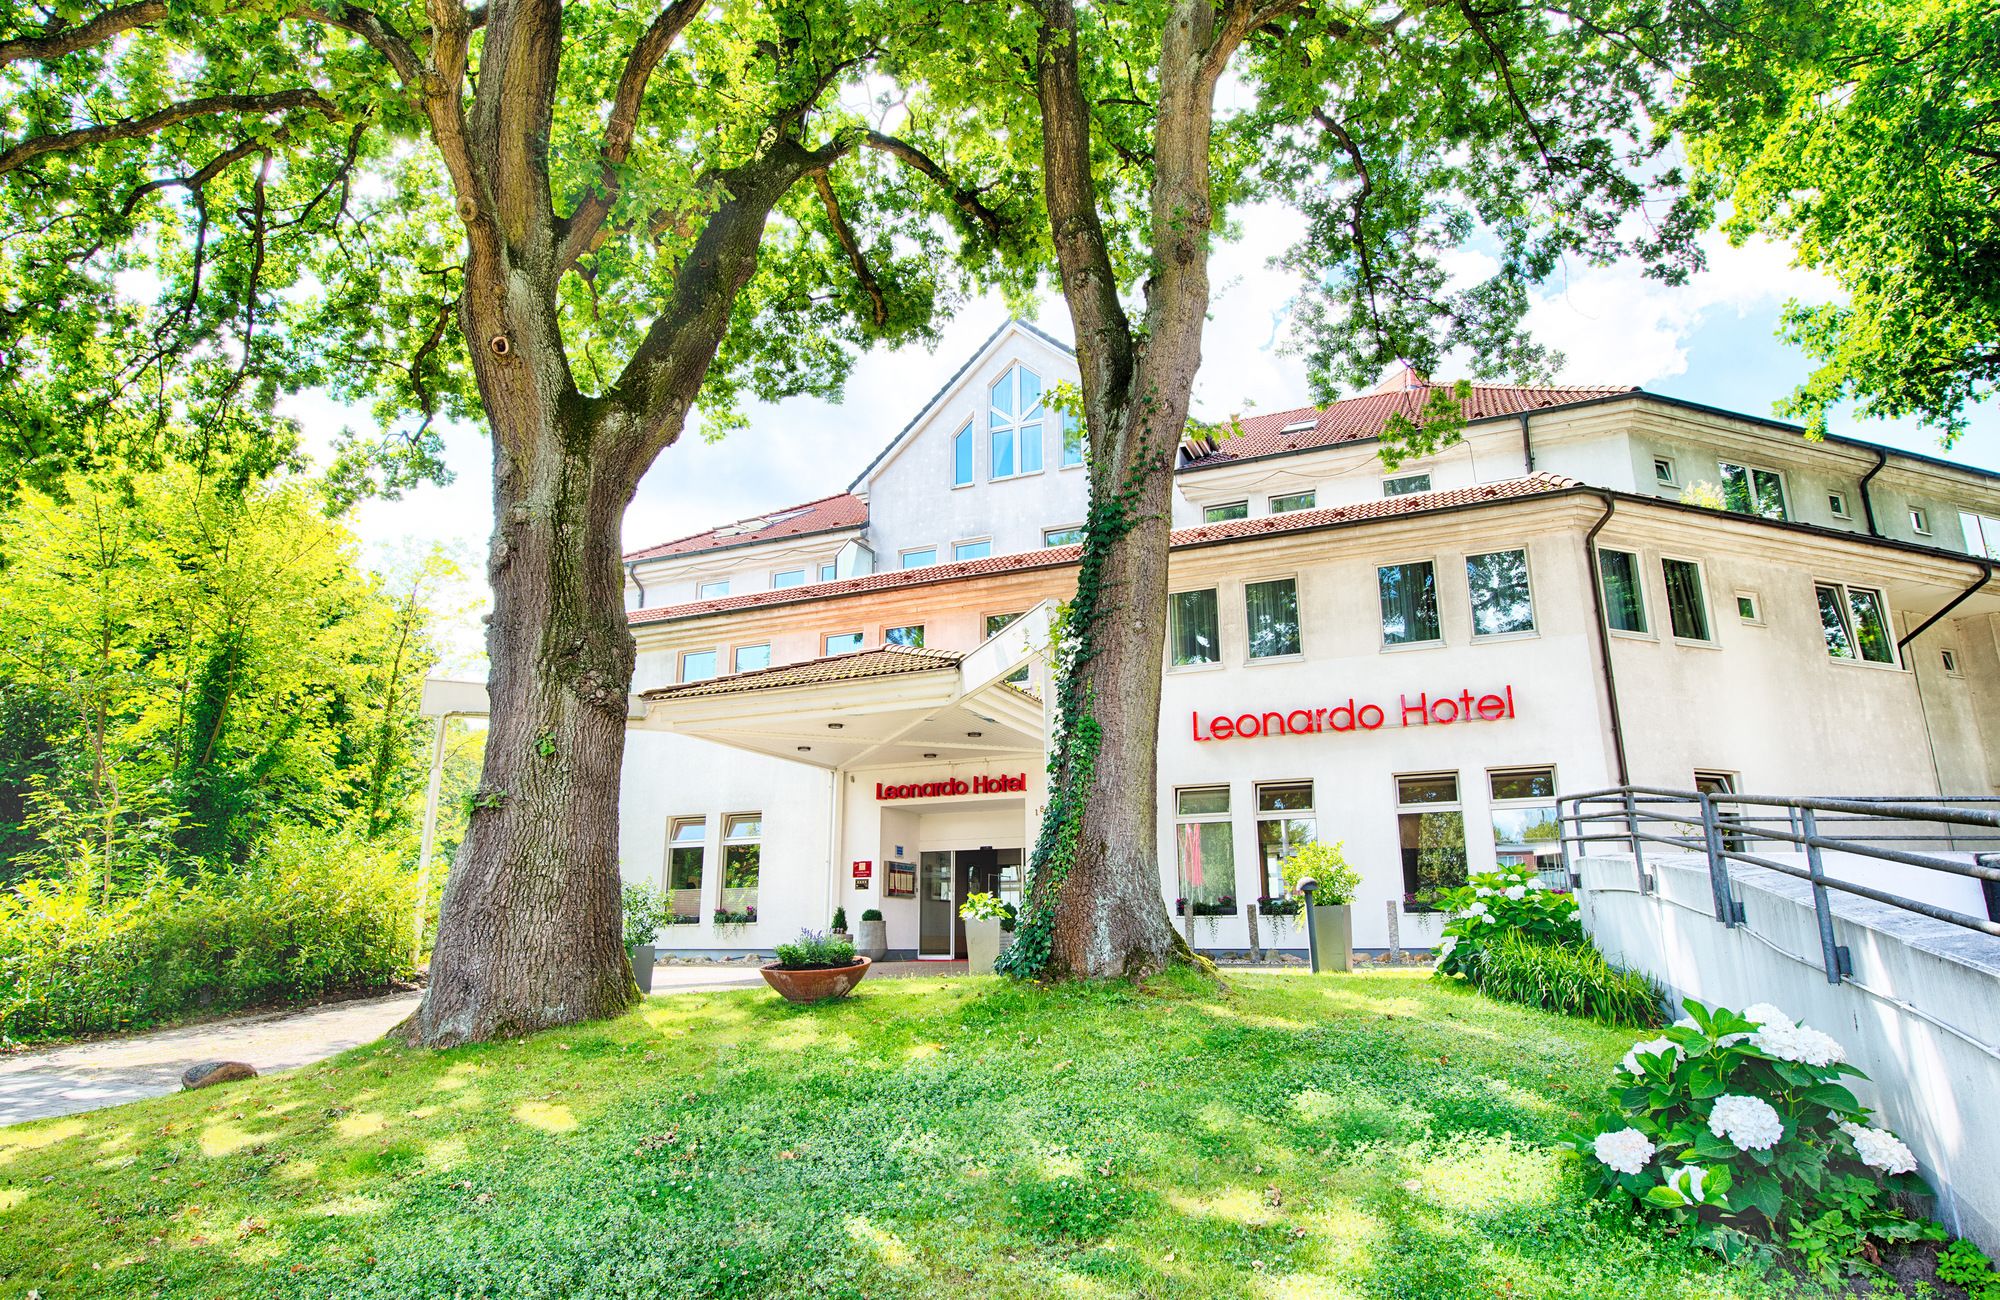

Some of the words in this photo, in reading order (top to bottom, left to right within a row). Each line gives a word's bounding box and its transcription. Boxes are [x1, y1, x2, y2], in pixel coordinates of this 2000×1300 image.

[1193, 698, 1385, 742] Leonardo
[1400, 685, 1515, 727] Hotel
[876, 777, 969, 800] Leonardo
[973, 773, 1027, 794] Hotel
